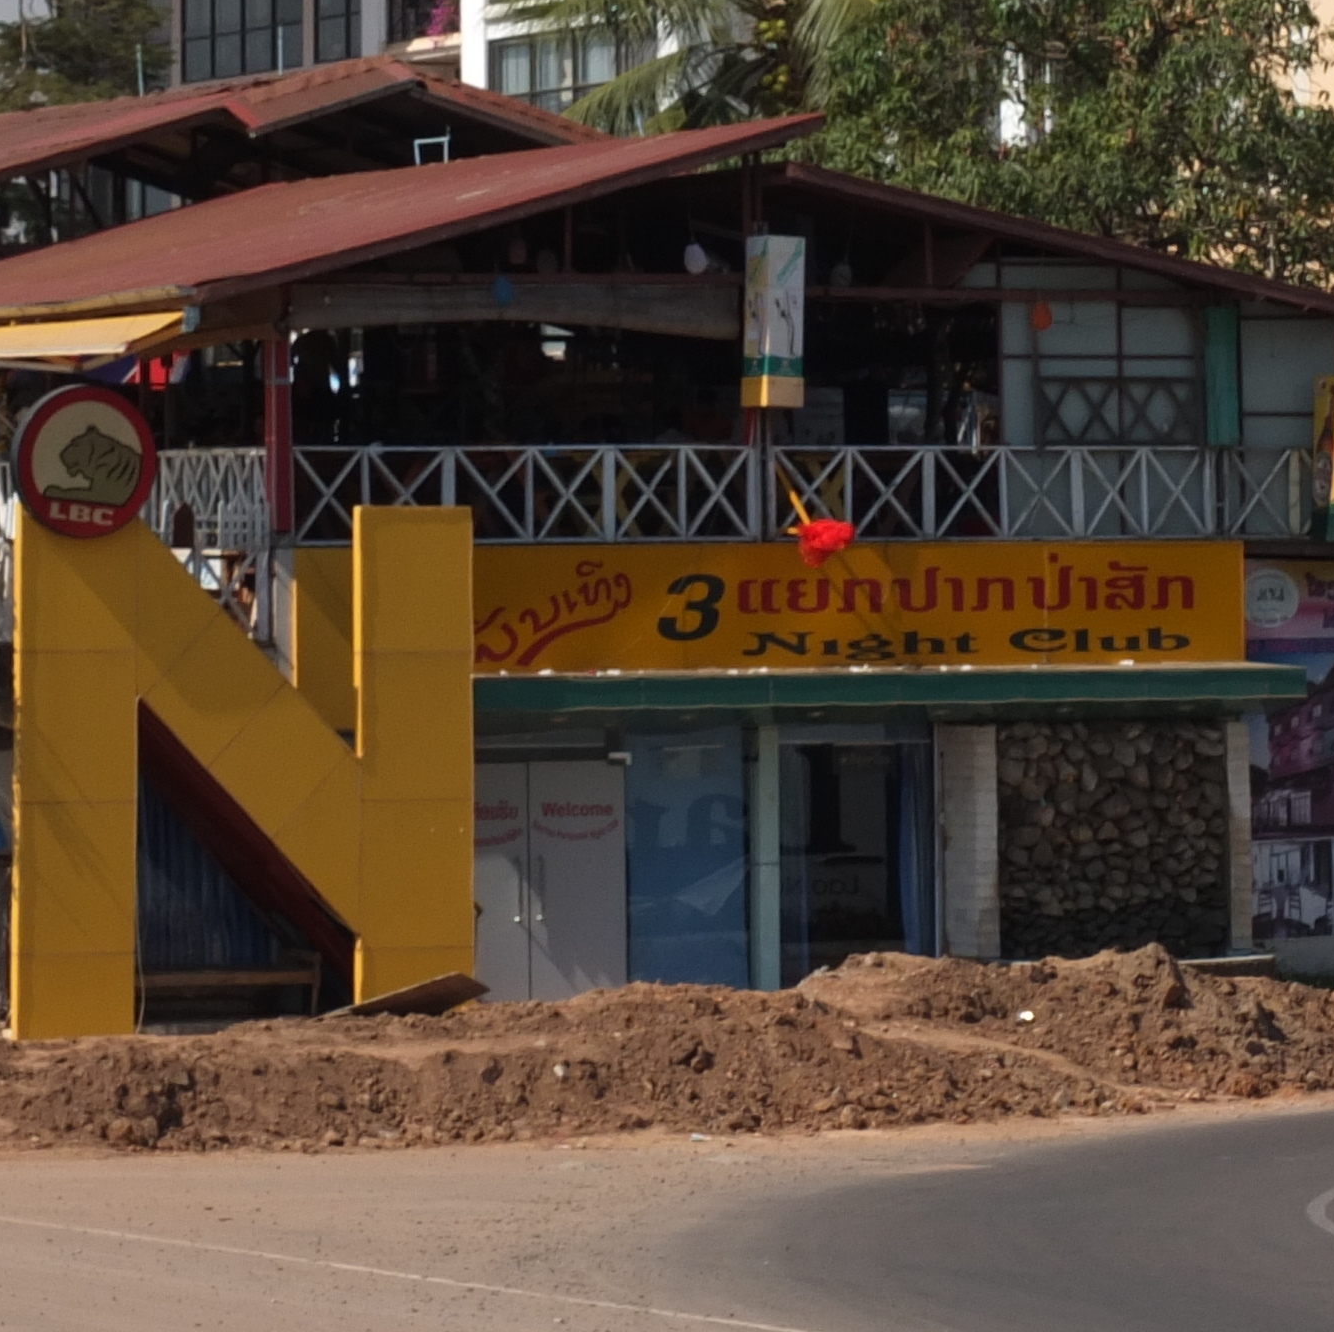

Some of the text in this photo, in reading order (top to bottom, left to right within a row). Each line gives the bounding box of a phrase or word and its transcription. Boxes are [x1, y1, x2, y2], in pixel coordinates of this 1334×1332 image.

[49, 502, 114, 526] LBC
[657, 574, 726, 641] 3
[743, 626, 1191, 662] Night Club
[541, 801, 614, 817] Welcome
